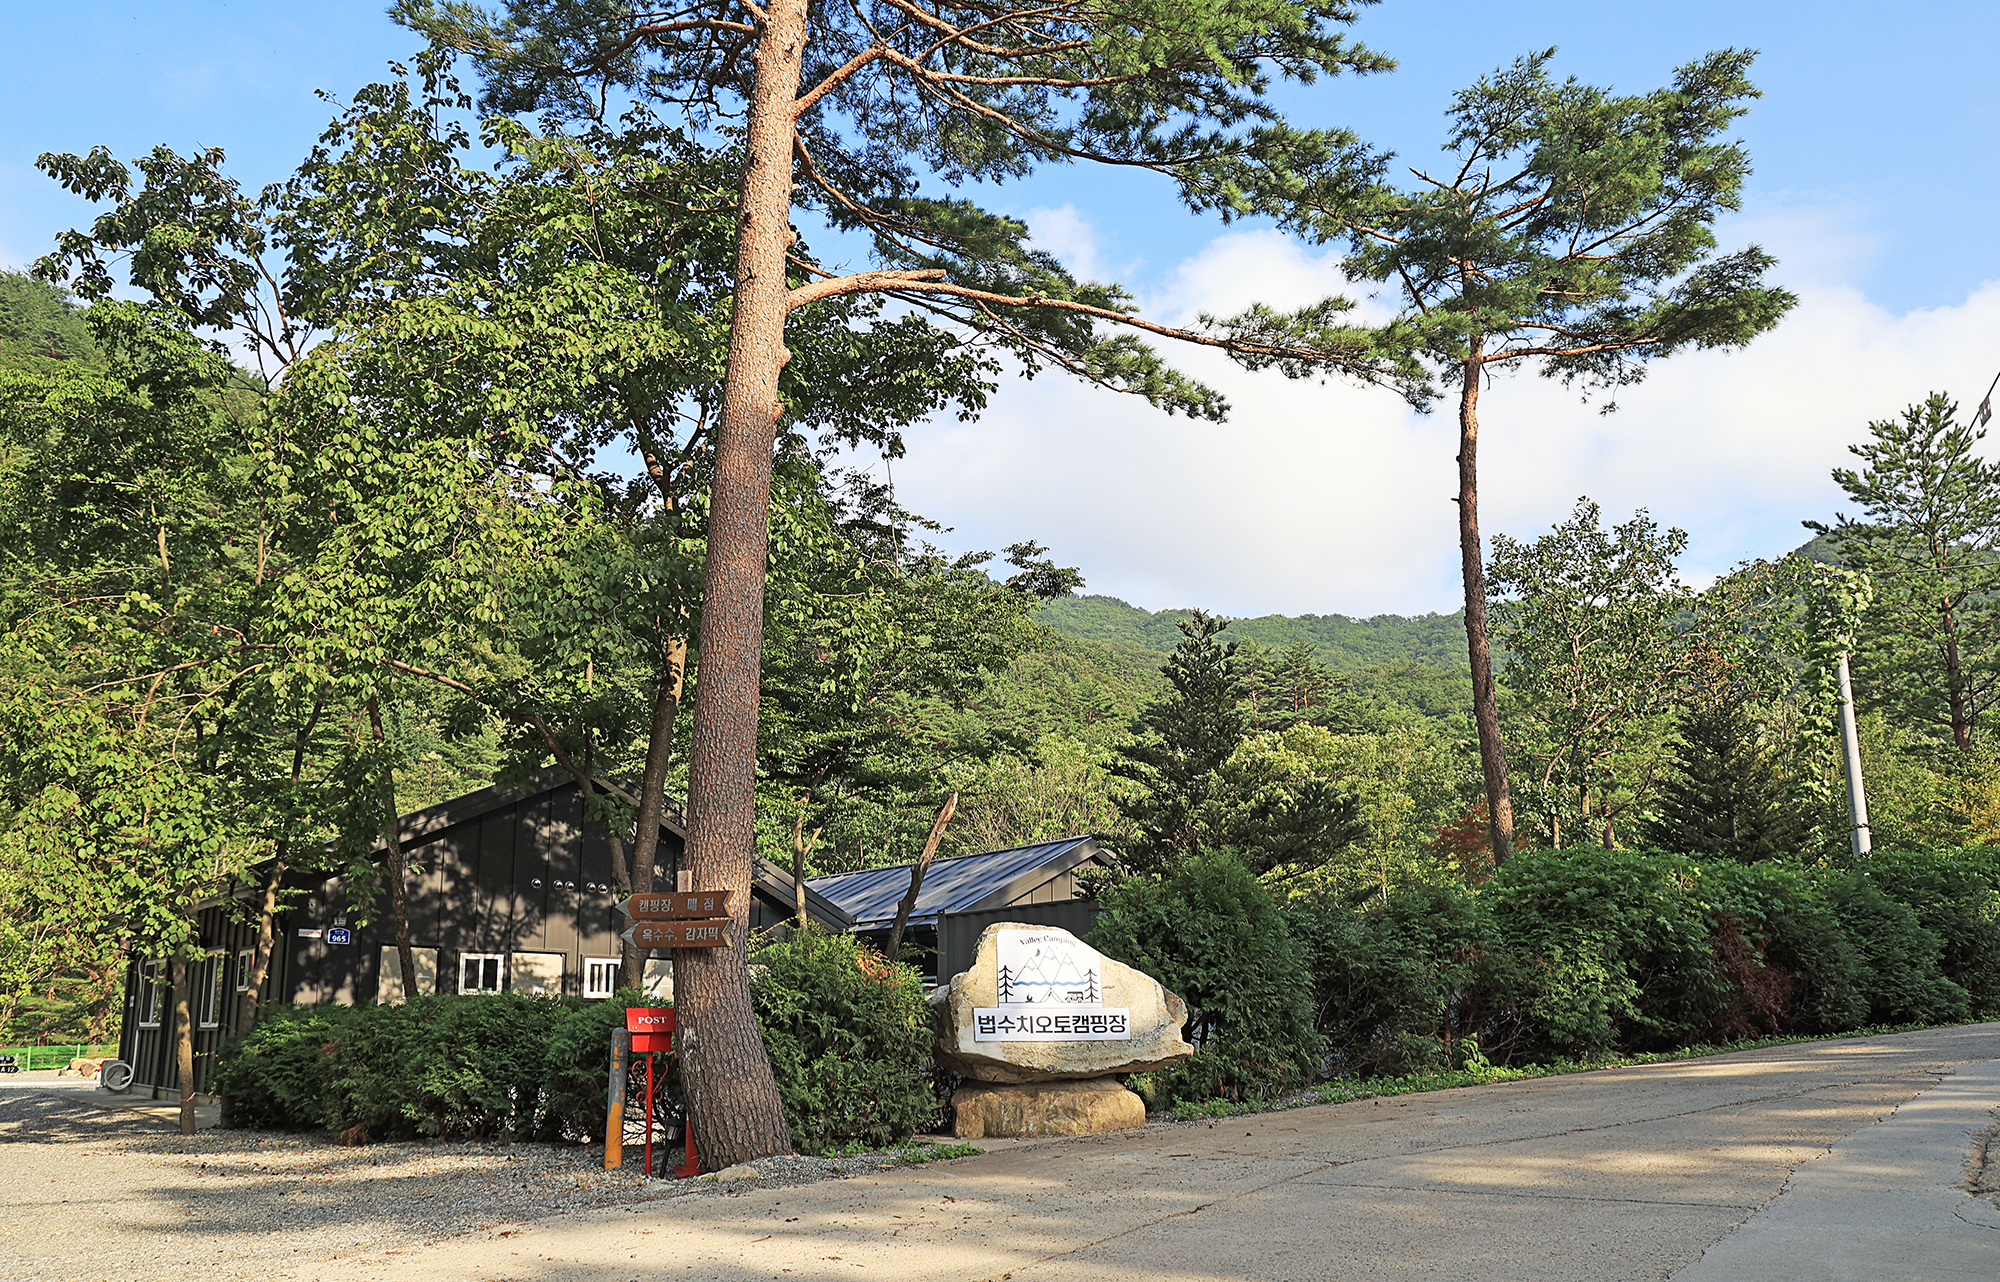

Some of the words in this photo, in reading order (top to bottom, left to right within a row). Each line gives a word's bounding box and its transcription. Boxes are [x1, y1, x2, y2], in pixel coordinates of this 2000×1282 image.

[639, 898, 674, 912] 캠핑장,
[642, 928, 678, 941] 옥수수,
[685, 927, 719, 940] 감자떡
[1019, 936, 1042, 945] Valley
[1043, 935, 1076, 947] Camping
[637, 1016, 667, 1024] POST
[977, 1015, 1127, 1034] 법수치오토캠핑장
